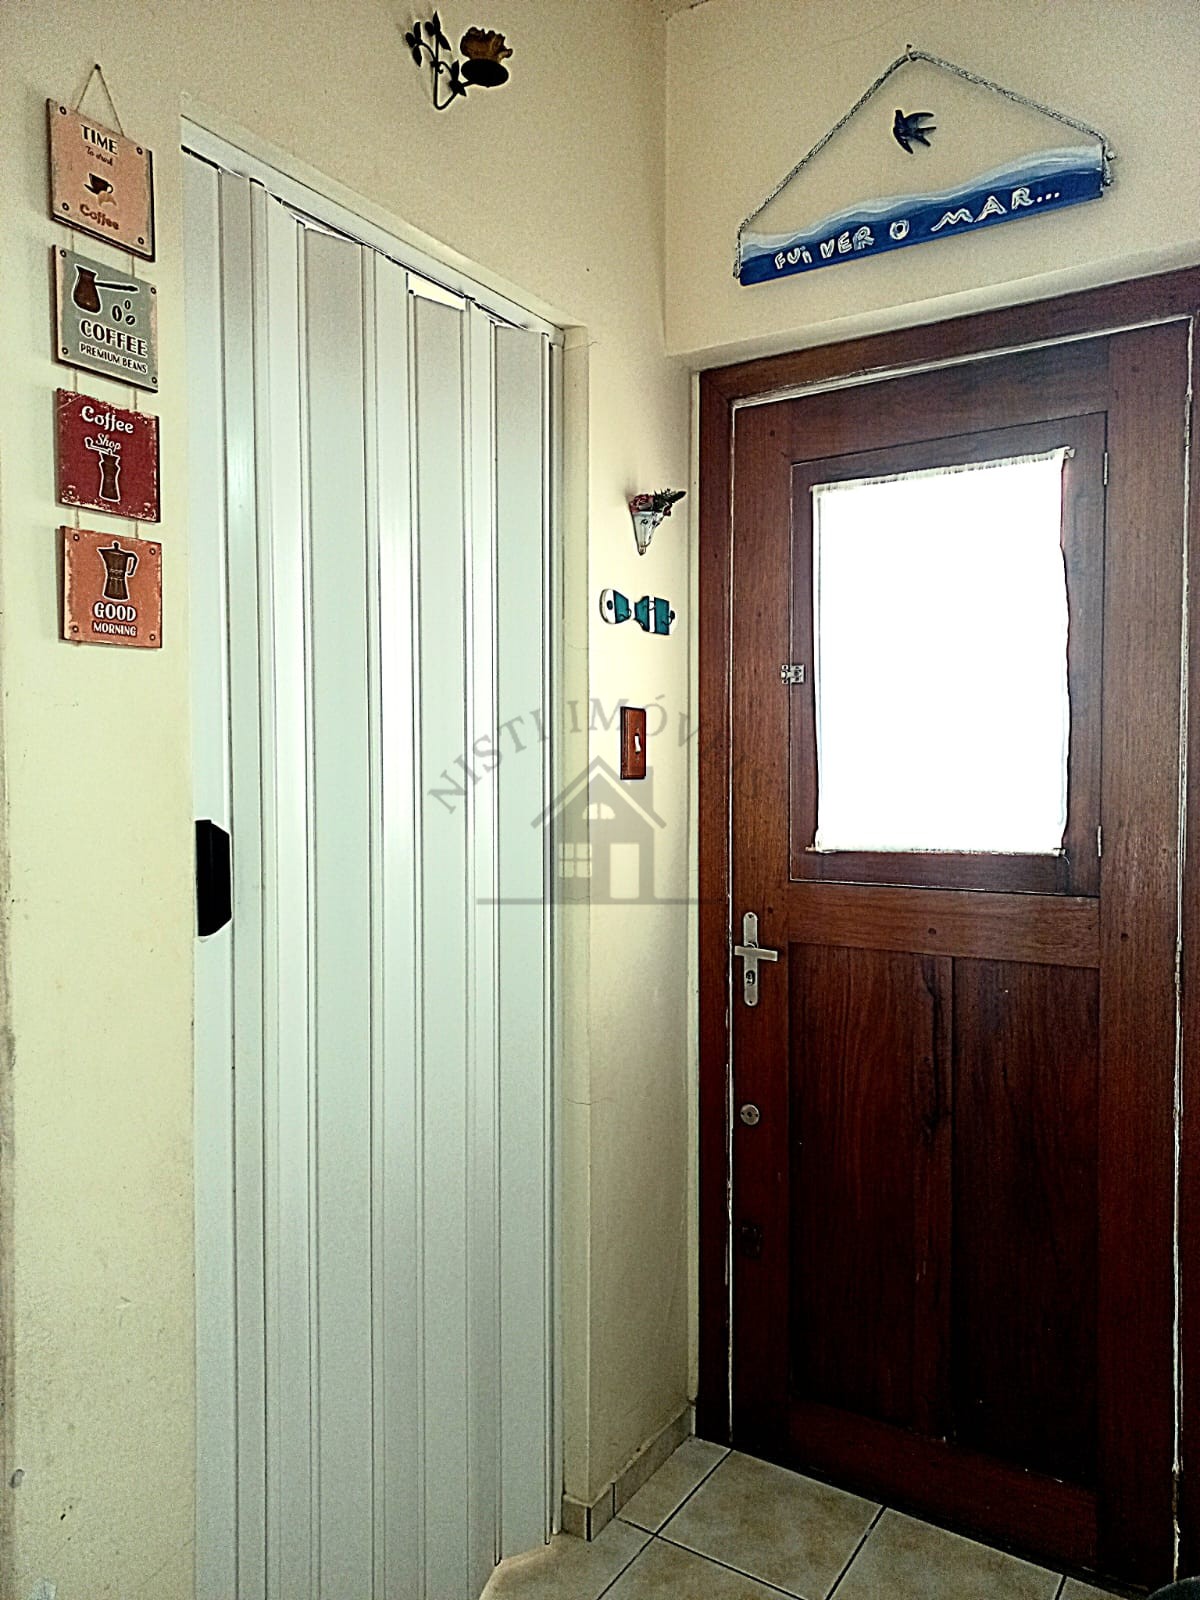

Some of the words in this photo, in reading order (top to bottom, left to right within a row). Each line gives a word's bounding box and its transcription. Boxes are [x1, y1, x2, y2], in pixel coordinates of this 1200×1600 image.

[80, 124, 119, 155] TIME
[80, 203, 119, 231] Coffee
[820, 226, 875, 259] VER
[889, 220, 910, 240] O
[80, 320, 148, 357] COFFEE
[80, 343, 121, 364] PREMIUM
[122, 358, 148, 374] BEANS
[82, 406, 134, 433] Coffee
[96, 433, 122, 452] Shop
[93, 601, 137, 622] GOOD
[93, 621, 137, 636] MORNING
